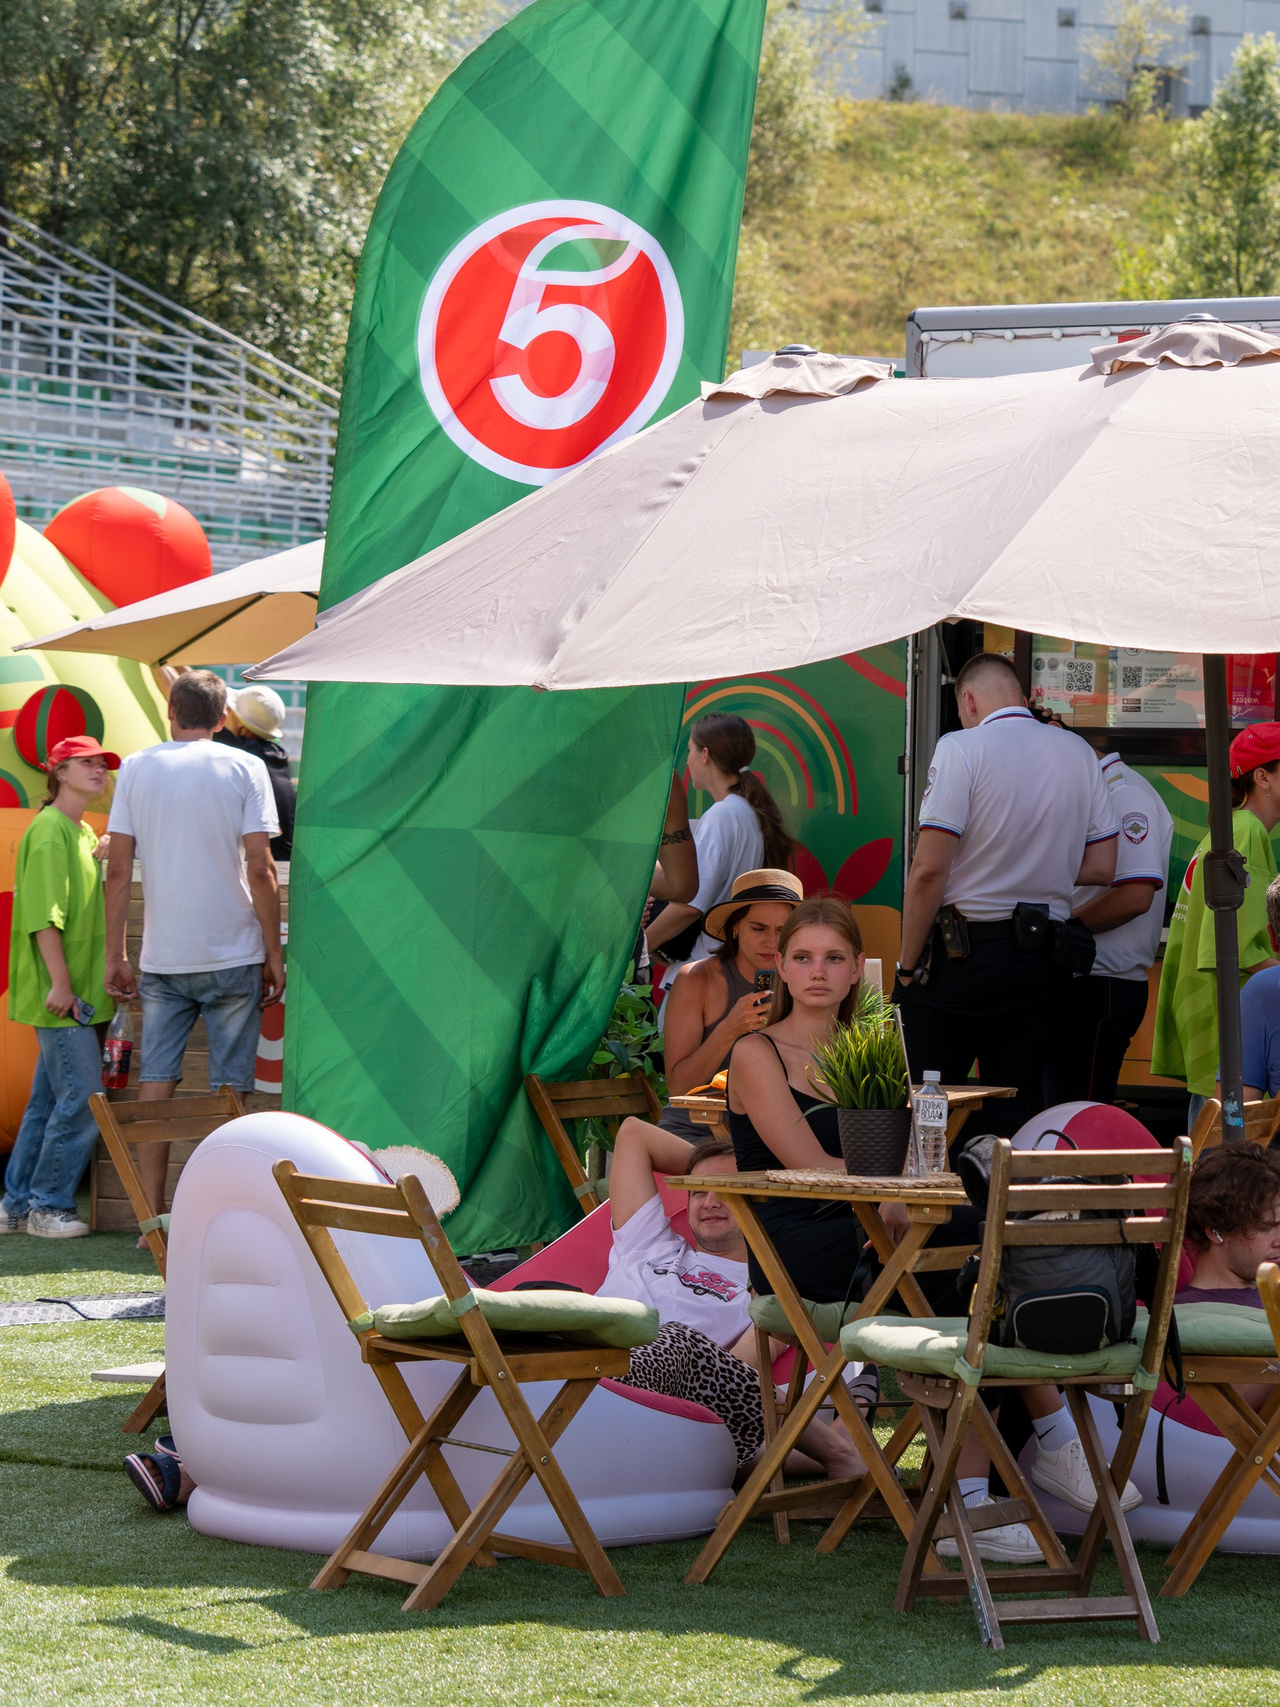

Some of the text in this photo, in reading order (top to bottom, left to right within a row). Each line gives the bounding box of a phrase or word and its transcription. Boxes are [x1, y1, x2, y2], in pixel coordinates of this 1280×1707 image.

[489, 223, 645, 430] 5
[922, 1100, 944, 1111] ТОЛЬКО
[921, 1109, 939, 1120] ВОДА
